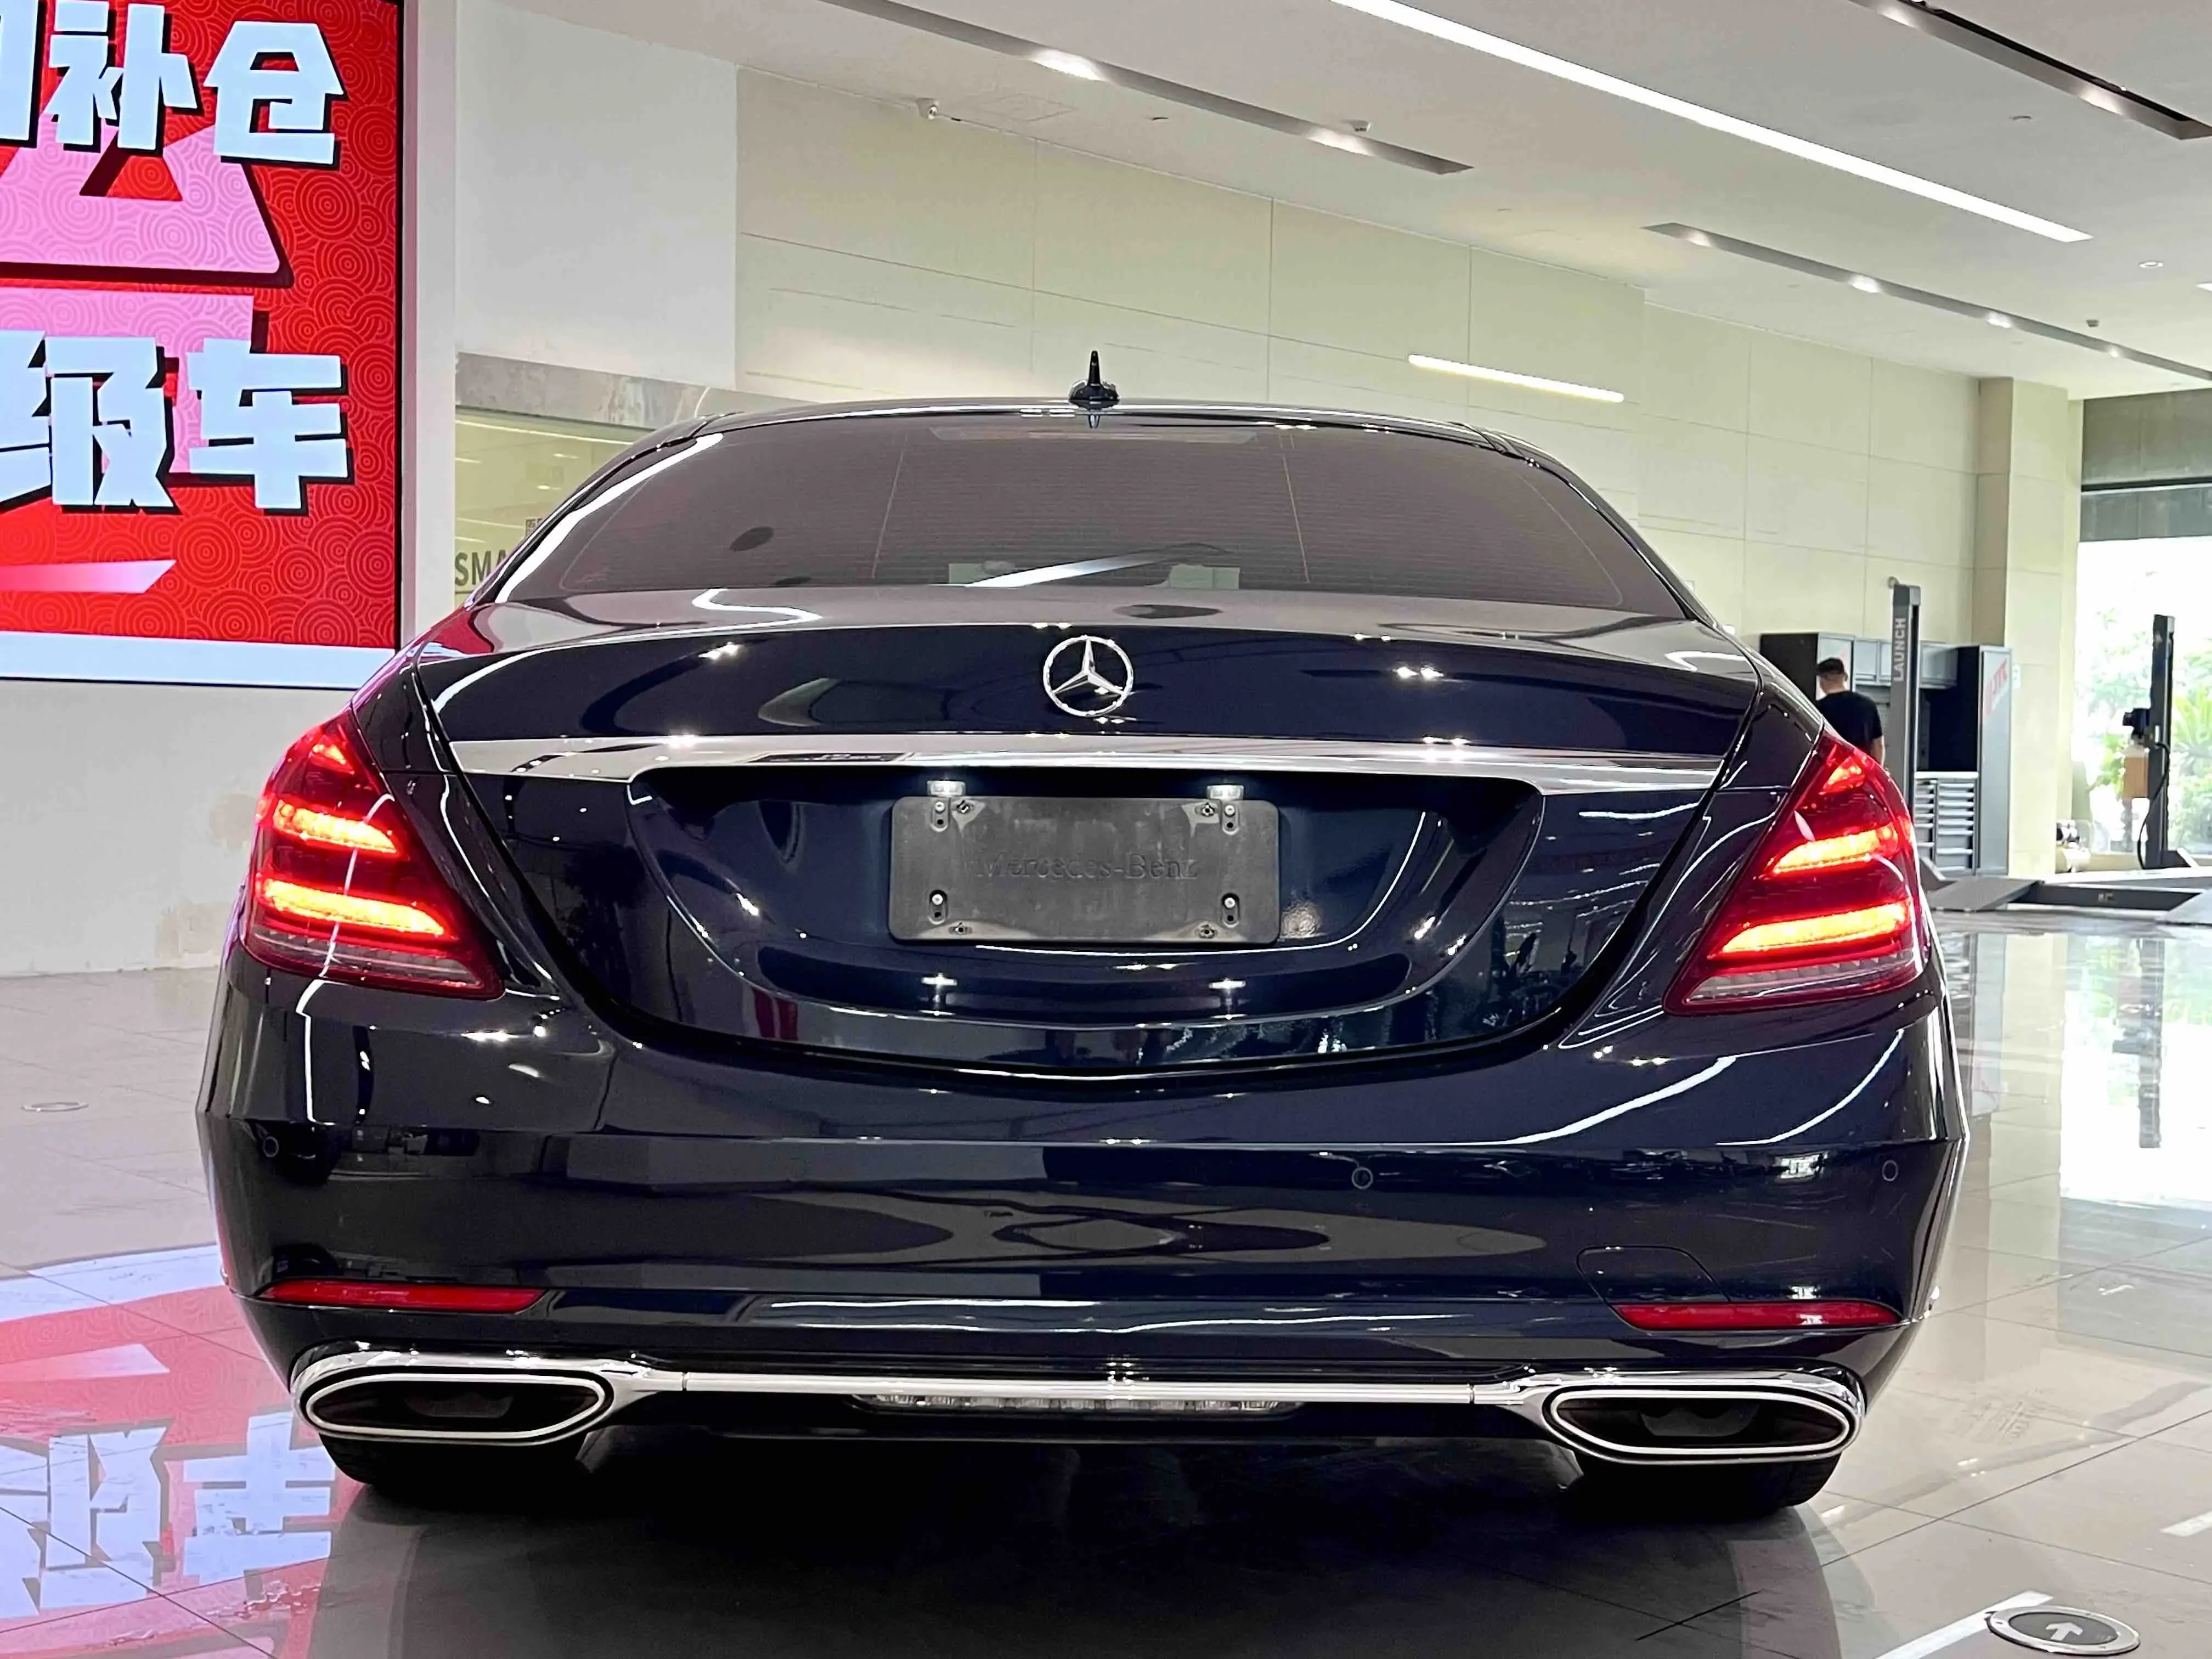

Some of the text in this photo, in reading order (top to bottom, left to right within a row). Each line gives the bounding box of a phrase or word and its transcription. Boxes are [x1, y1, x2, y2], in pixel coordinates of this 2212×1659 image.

[0, 0, 344, 164] 补仓
[1894, 618, 1906, 682] LAUNCH
[975, 852, 1198, 879] Mercedes-Benz
